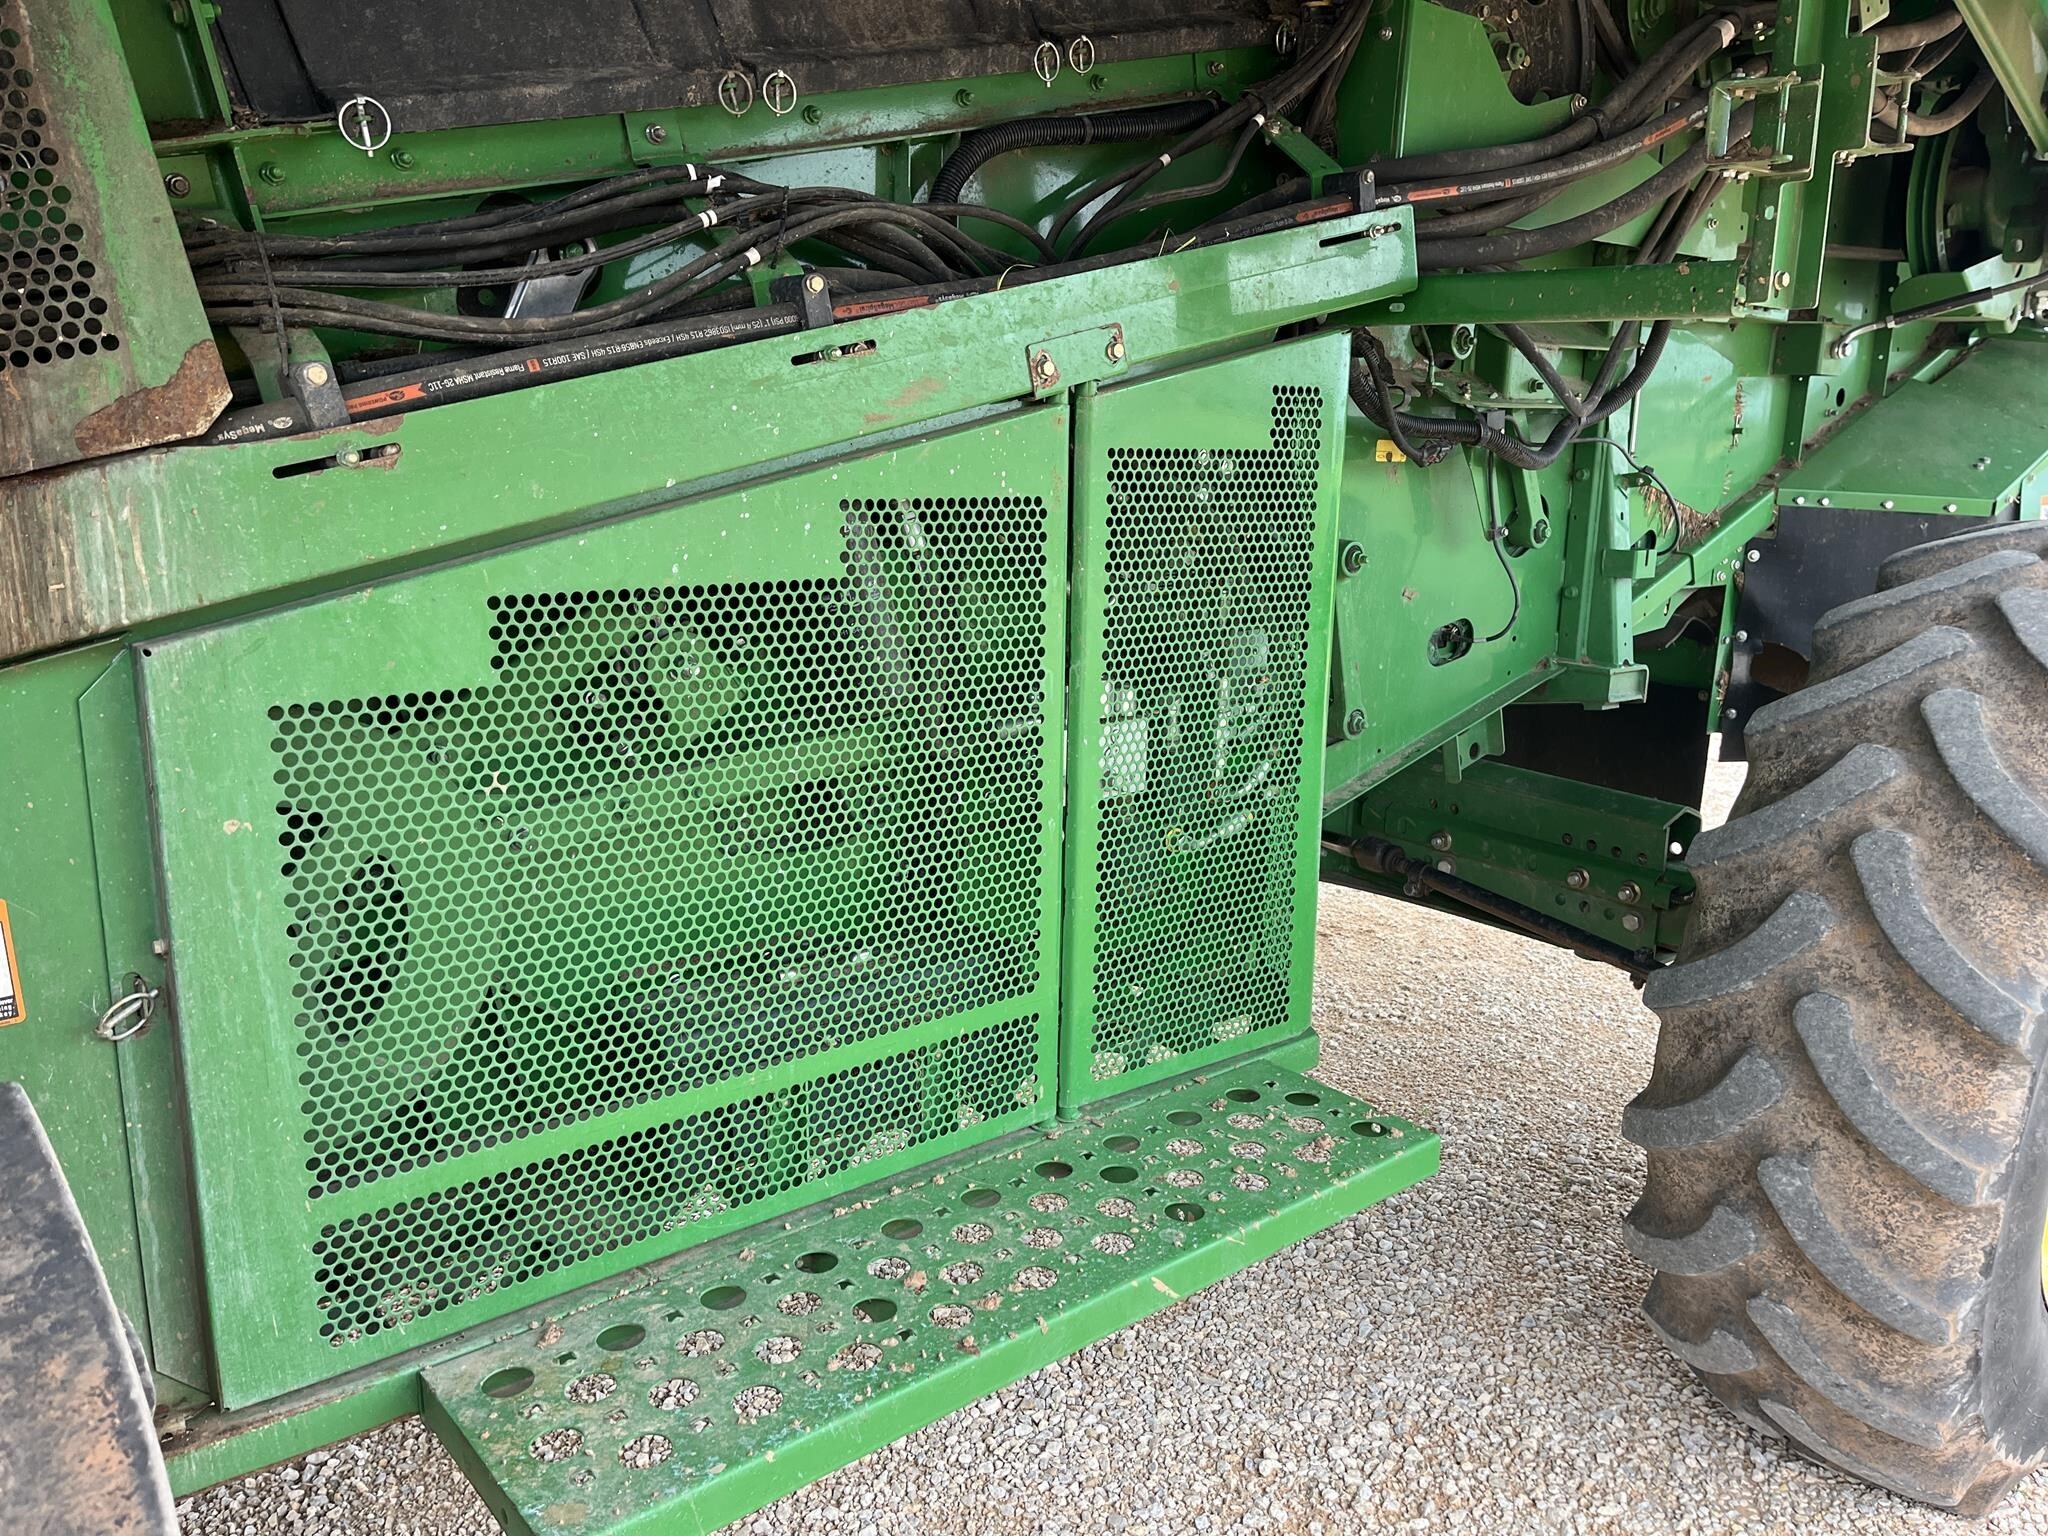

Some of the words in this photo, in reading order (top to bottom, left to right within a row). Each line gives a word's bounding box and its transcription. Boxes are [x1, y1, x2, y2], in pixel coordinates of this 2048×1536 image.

[642, 335, 670, 347] Exceeds
[542, 353, 570, 367] 100R15
[571, 351, 585, 361] SAE
[473, 366, 504, 380] Resistant
[503, 362, 524, 374] Flame
[427, 377, 454, 391] 2G-11C
[453, 373, 473, 385] MSHA
[216, 422, 265, 441] MegaSys
